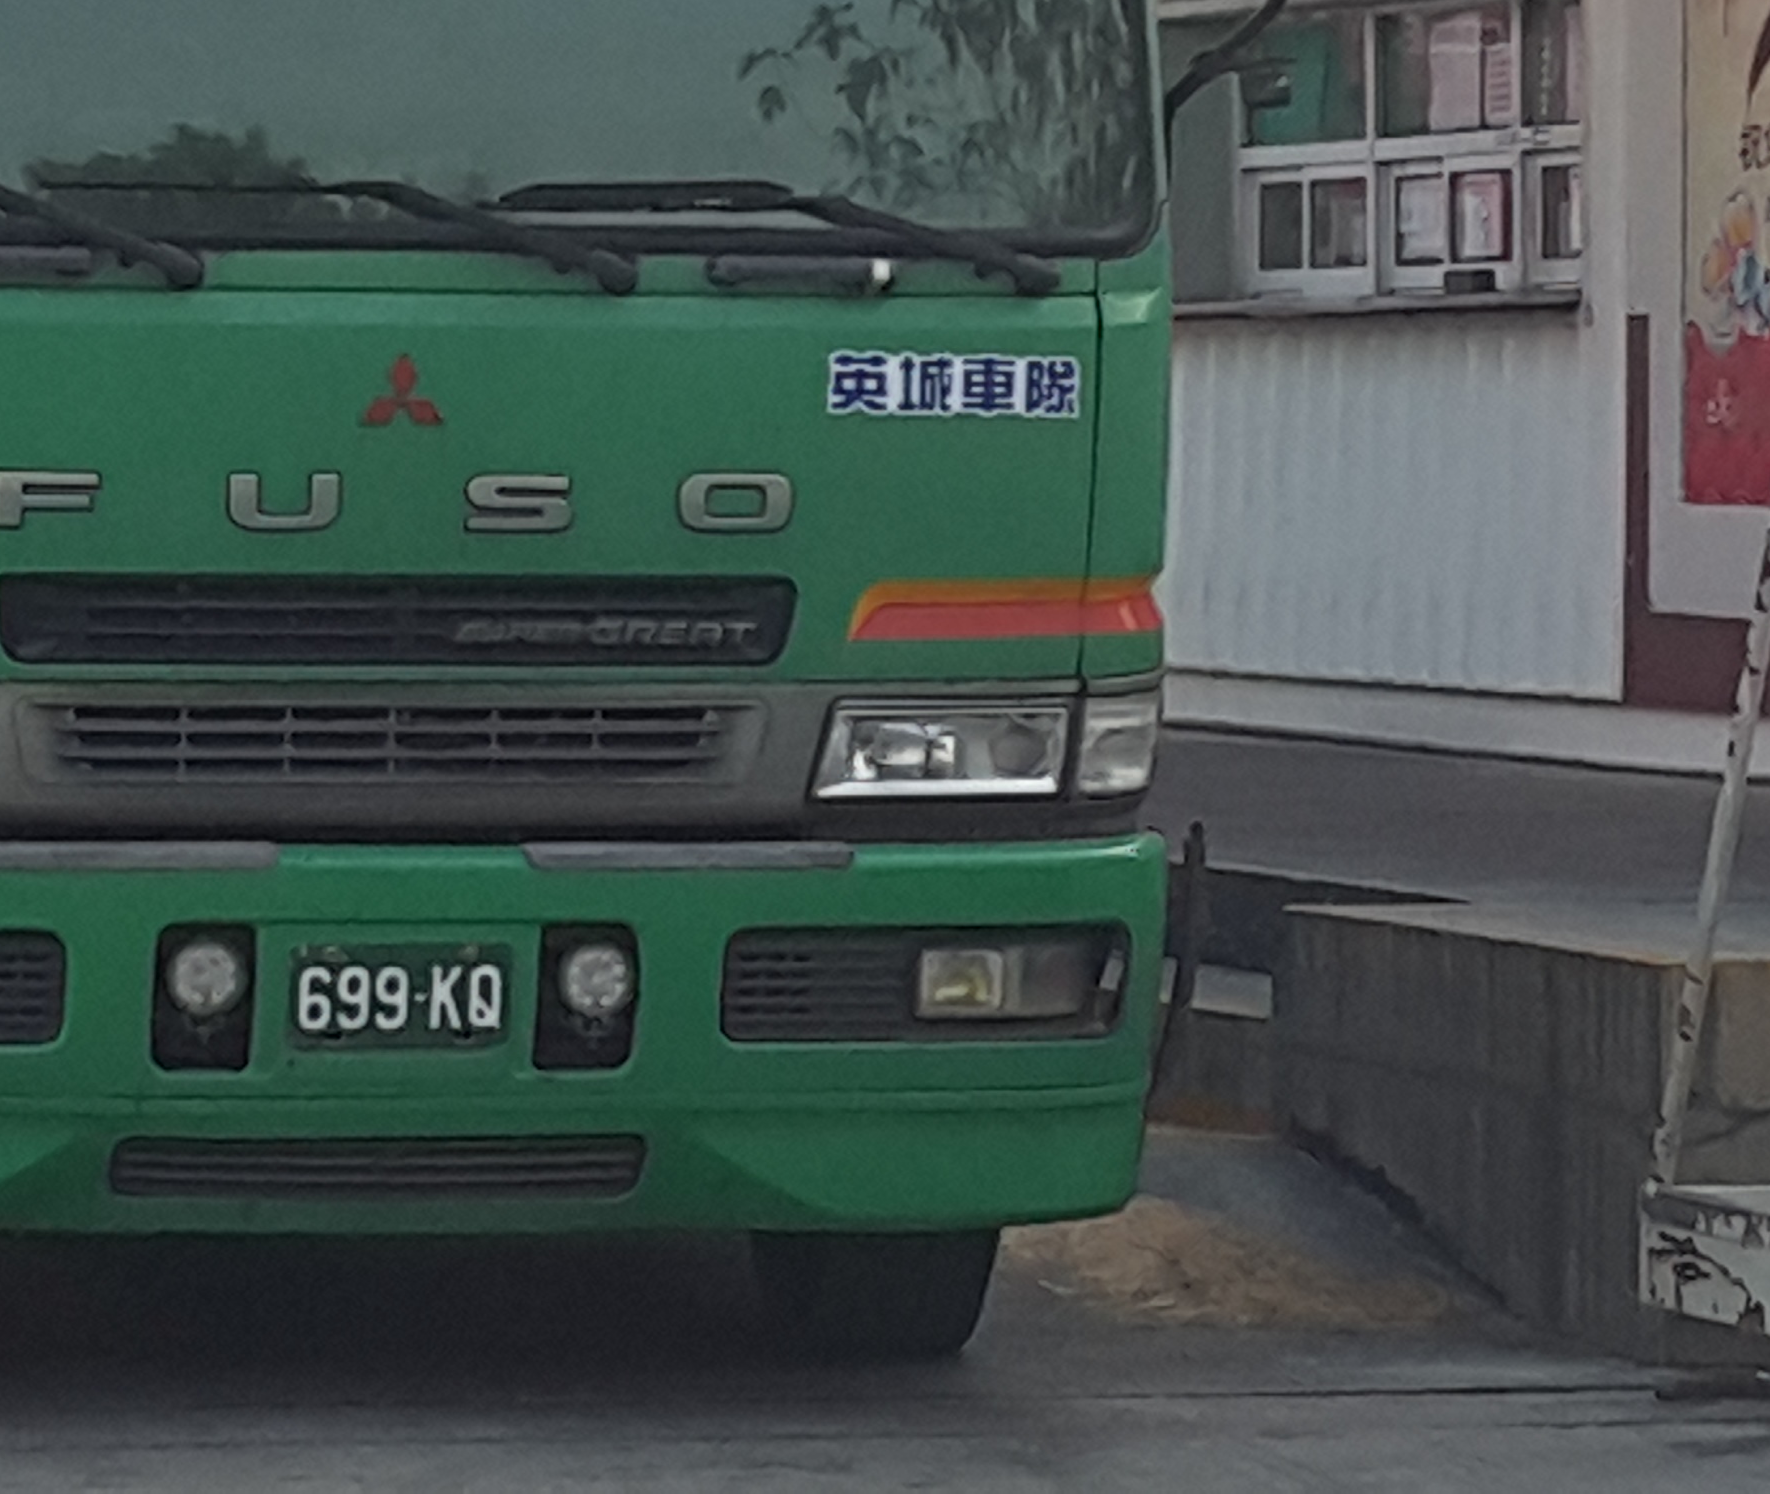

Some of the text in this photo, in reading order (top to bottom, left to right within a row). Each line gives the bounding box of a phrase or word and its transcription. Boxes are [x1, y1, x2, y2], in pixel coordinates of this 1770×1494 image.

[830, 354, 1077, 414] 英城車隊
[586, 617, 758, 645] GREAT
[297, 963, 503, 1031] 699-KQ
